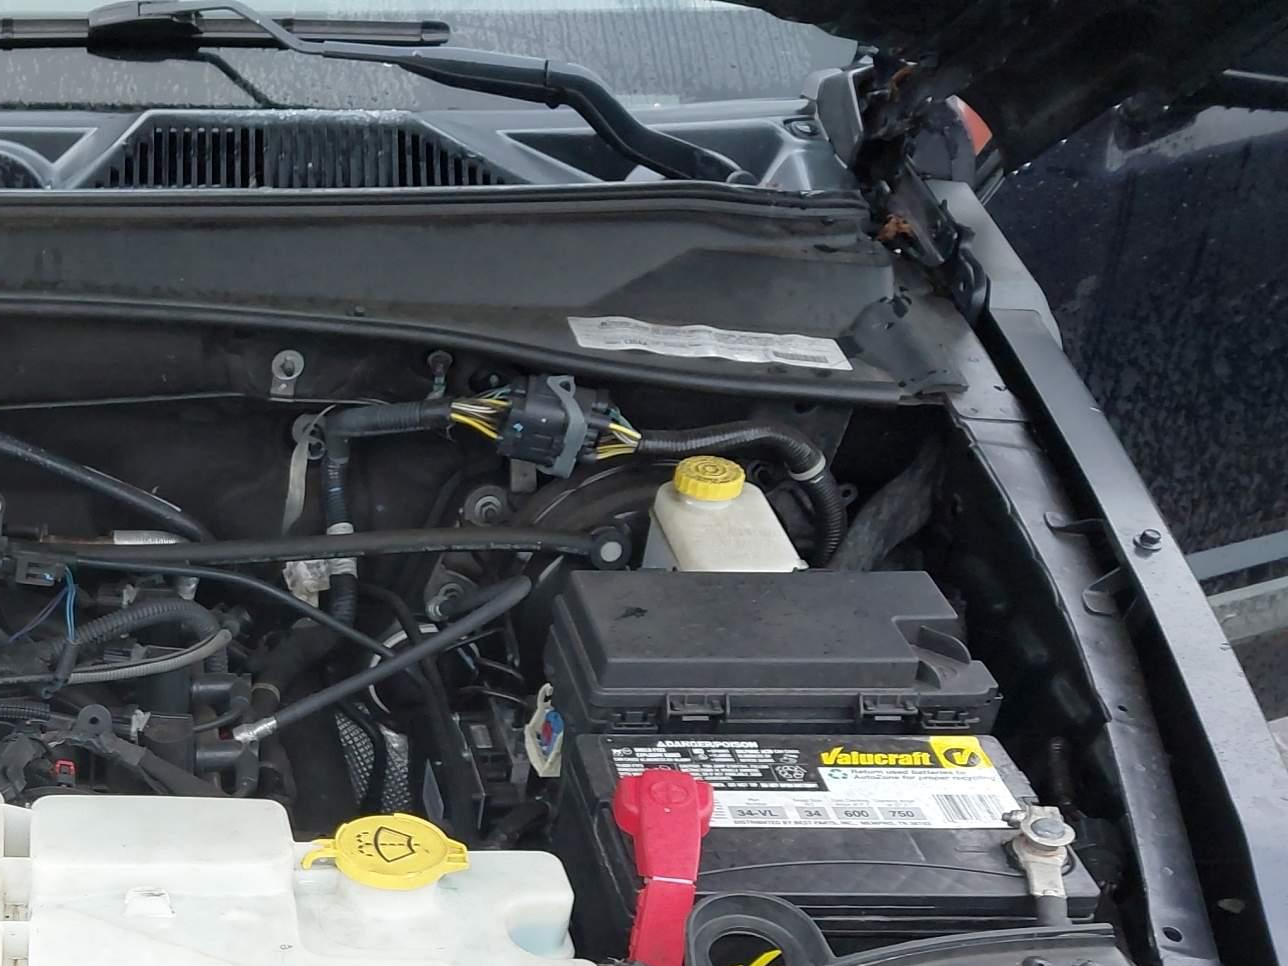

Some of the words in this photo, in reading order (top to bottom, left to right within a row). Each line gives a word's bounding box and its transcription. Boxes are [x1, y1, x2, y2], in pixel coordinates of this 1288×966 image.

[820, 746, 934, 766] Valucraft
[735, 809, 779, 818] 34-VL
[804, 809, 823, 818] 34
[843, 810, 870, 818] 600
[887, 810, 915, 818] 750
